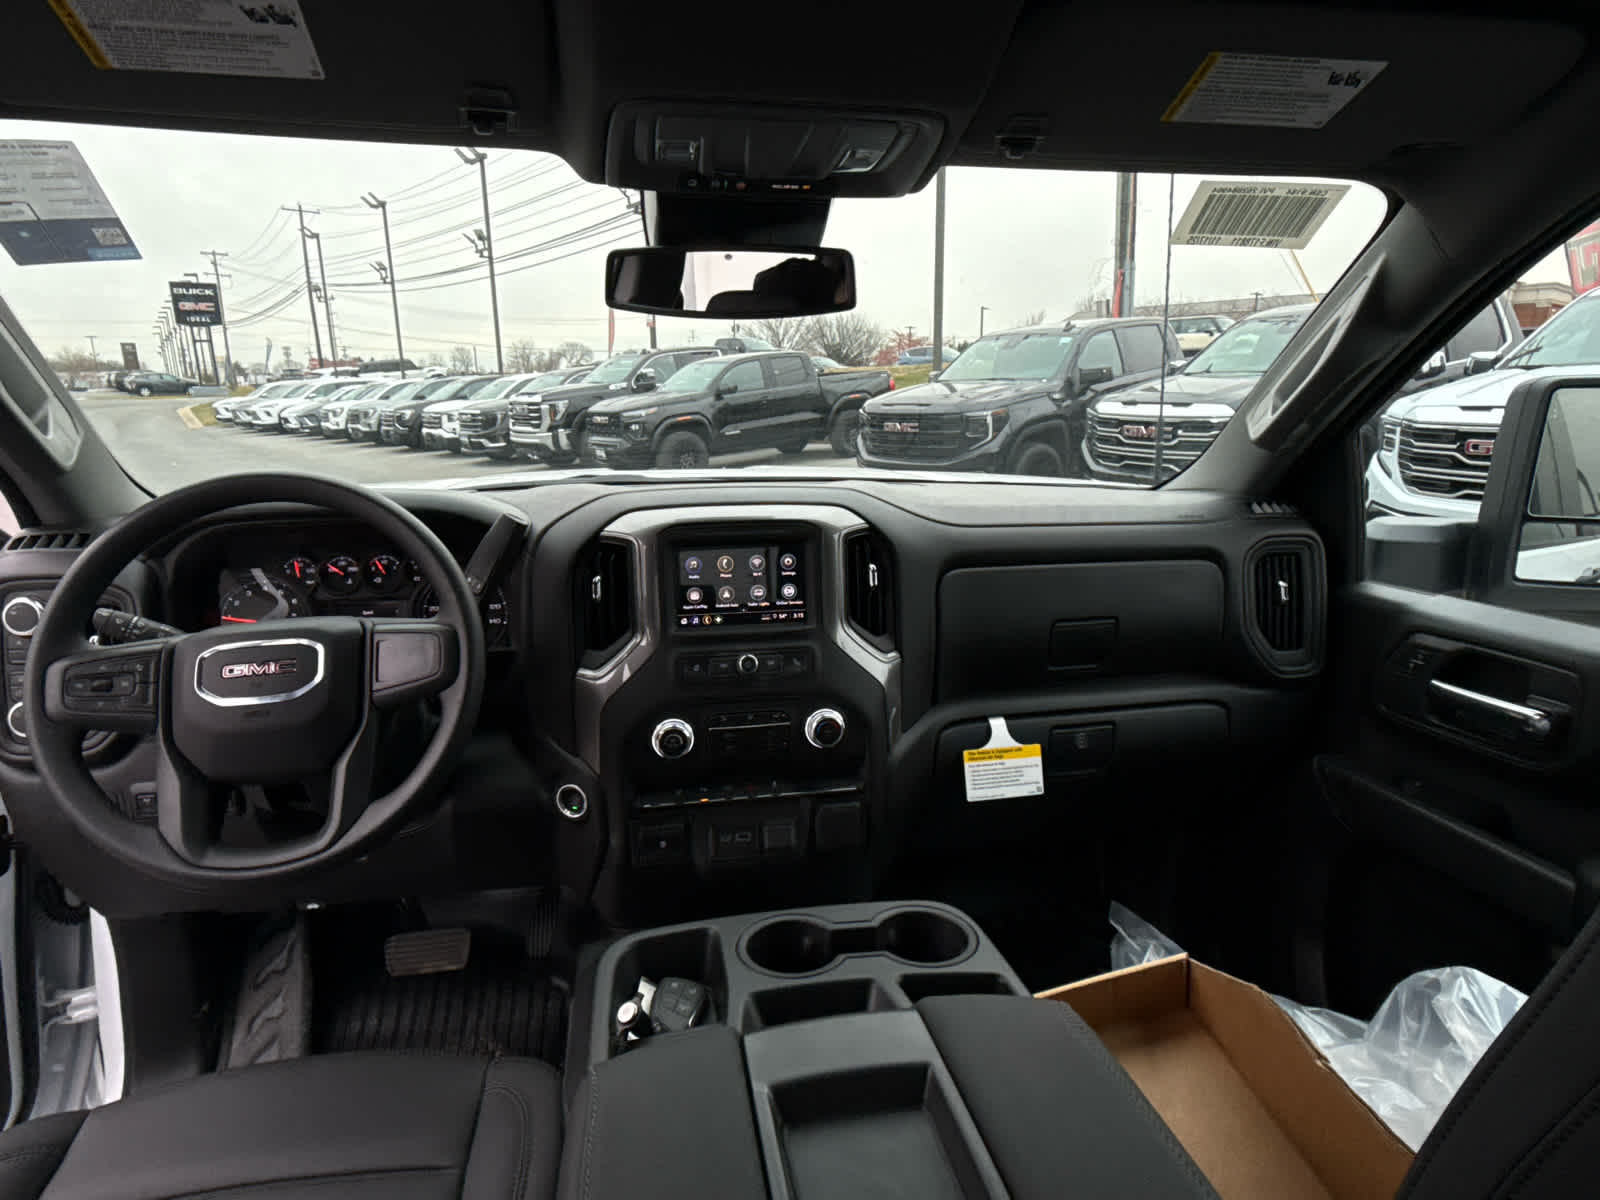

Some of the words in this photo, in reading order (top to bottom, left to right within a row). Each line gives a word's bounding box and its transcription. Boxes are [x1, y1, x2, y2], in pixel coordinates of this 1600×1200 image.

[173, 287, 214, 295] BUICK
[178, 301, 215, 310] GMC
[883, 422, 920, 433] GMC
[1122, 424, 1174, 440] GMC
[222, 659, 297, 679] GMC
